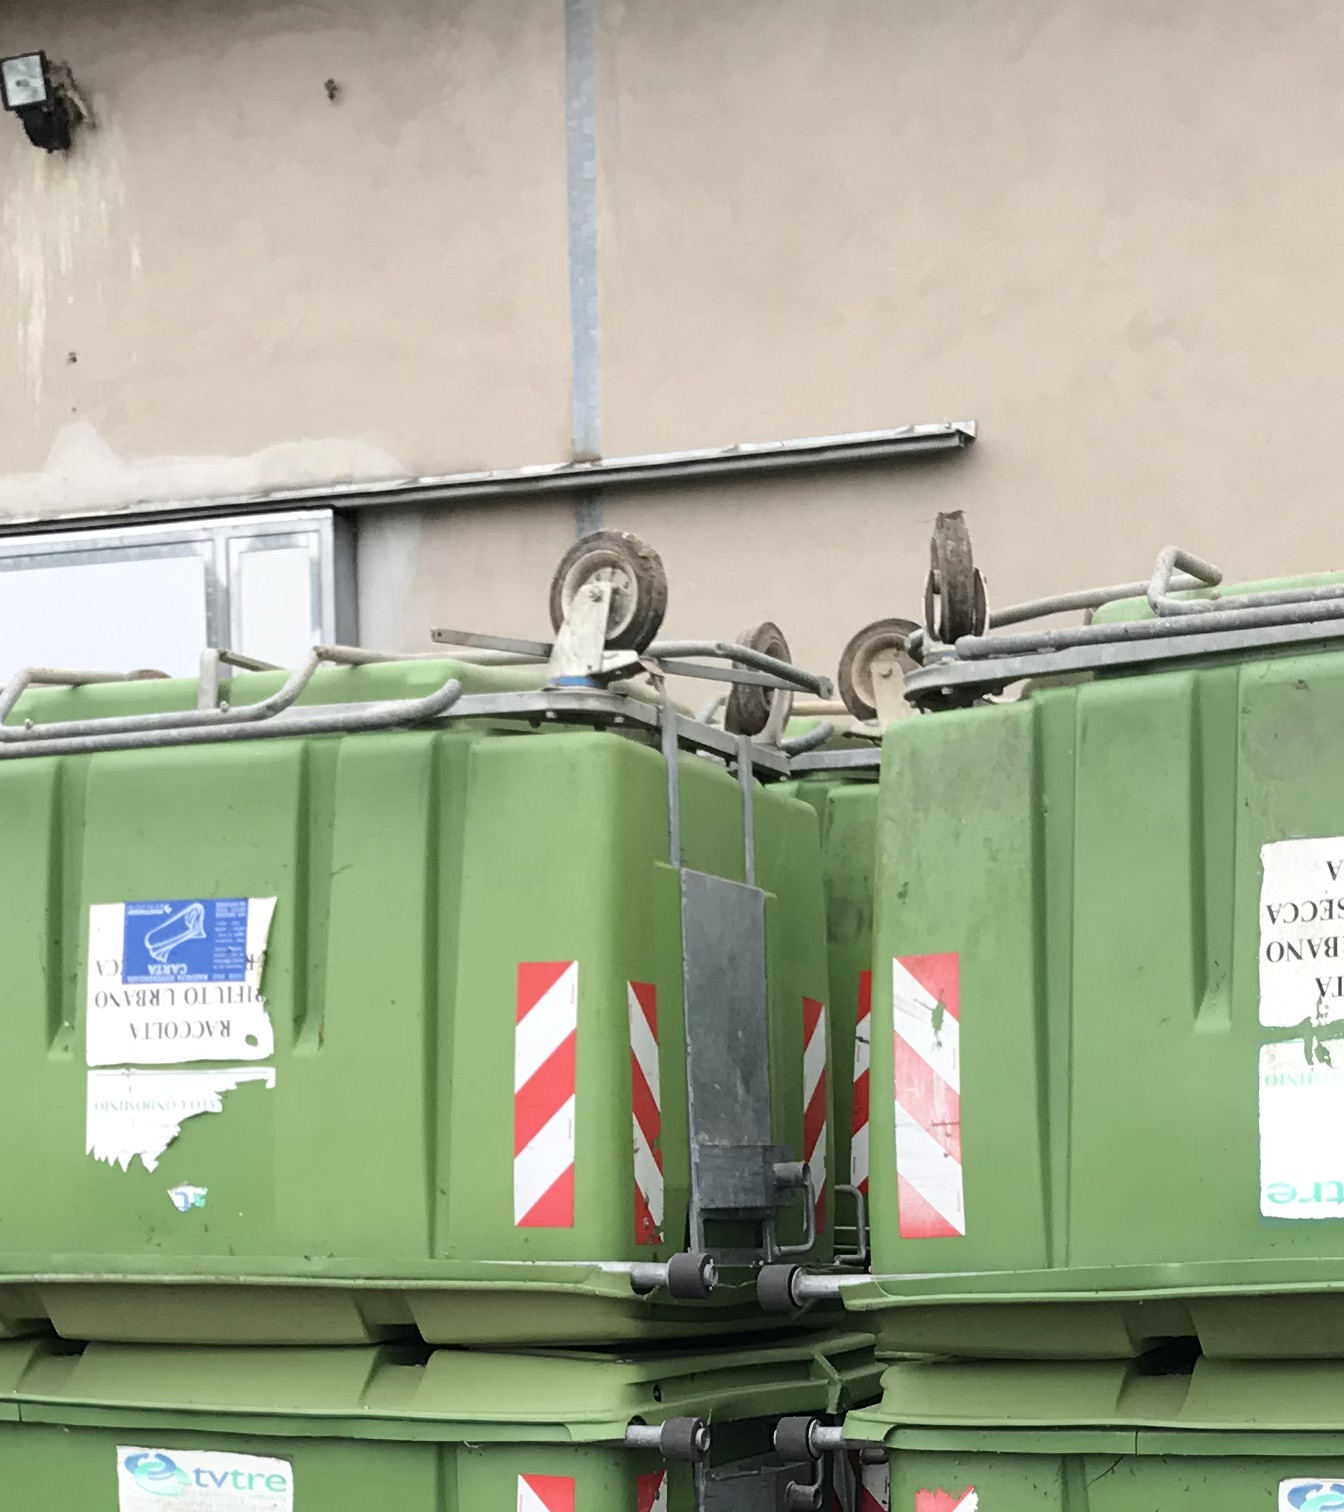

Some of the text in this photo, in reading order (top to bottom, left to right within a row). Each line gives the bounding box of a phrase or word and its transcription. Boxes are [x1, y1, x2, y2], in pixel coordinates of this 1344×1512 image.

[148, 963, 187, 975] CARTA
[95, 989, 175, 1008] URBANO
[129, 1020, 231, 1040] RACCOLTA
[193, 1466, 287, 1493] tvtre
